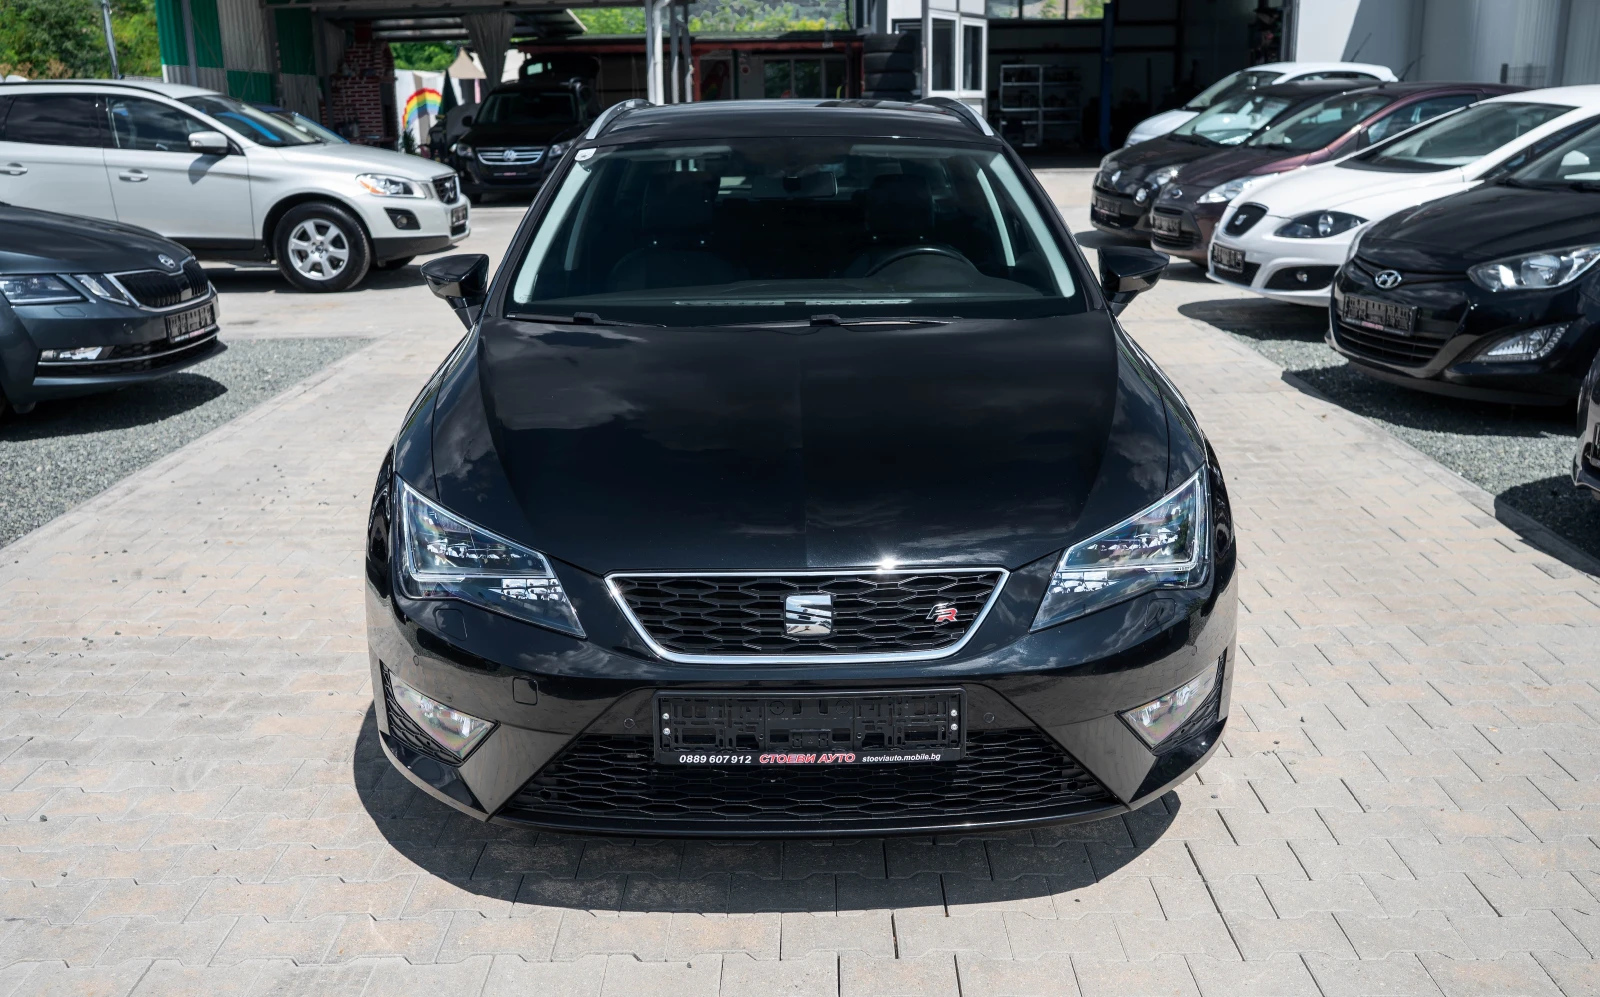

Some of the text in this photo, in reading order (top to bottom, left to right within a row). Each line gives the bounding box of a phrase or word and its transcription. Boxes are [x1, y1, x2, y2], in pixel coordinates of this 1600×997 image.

[679, 754, 752, 763] 0889 607 912
[759, 753, 856, 764] СТОЕВИ АУТО
[862, 753, 941, 763] stoeviauto.mobile.bg
